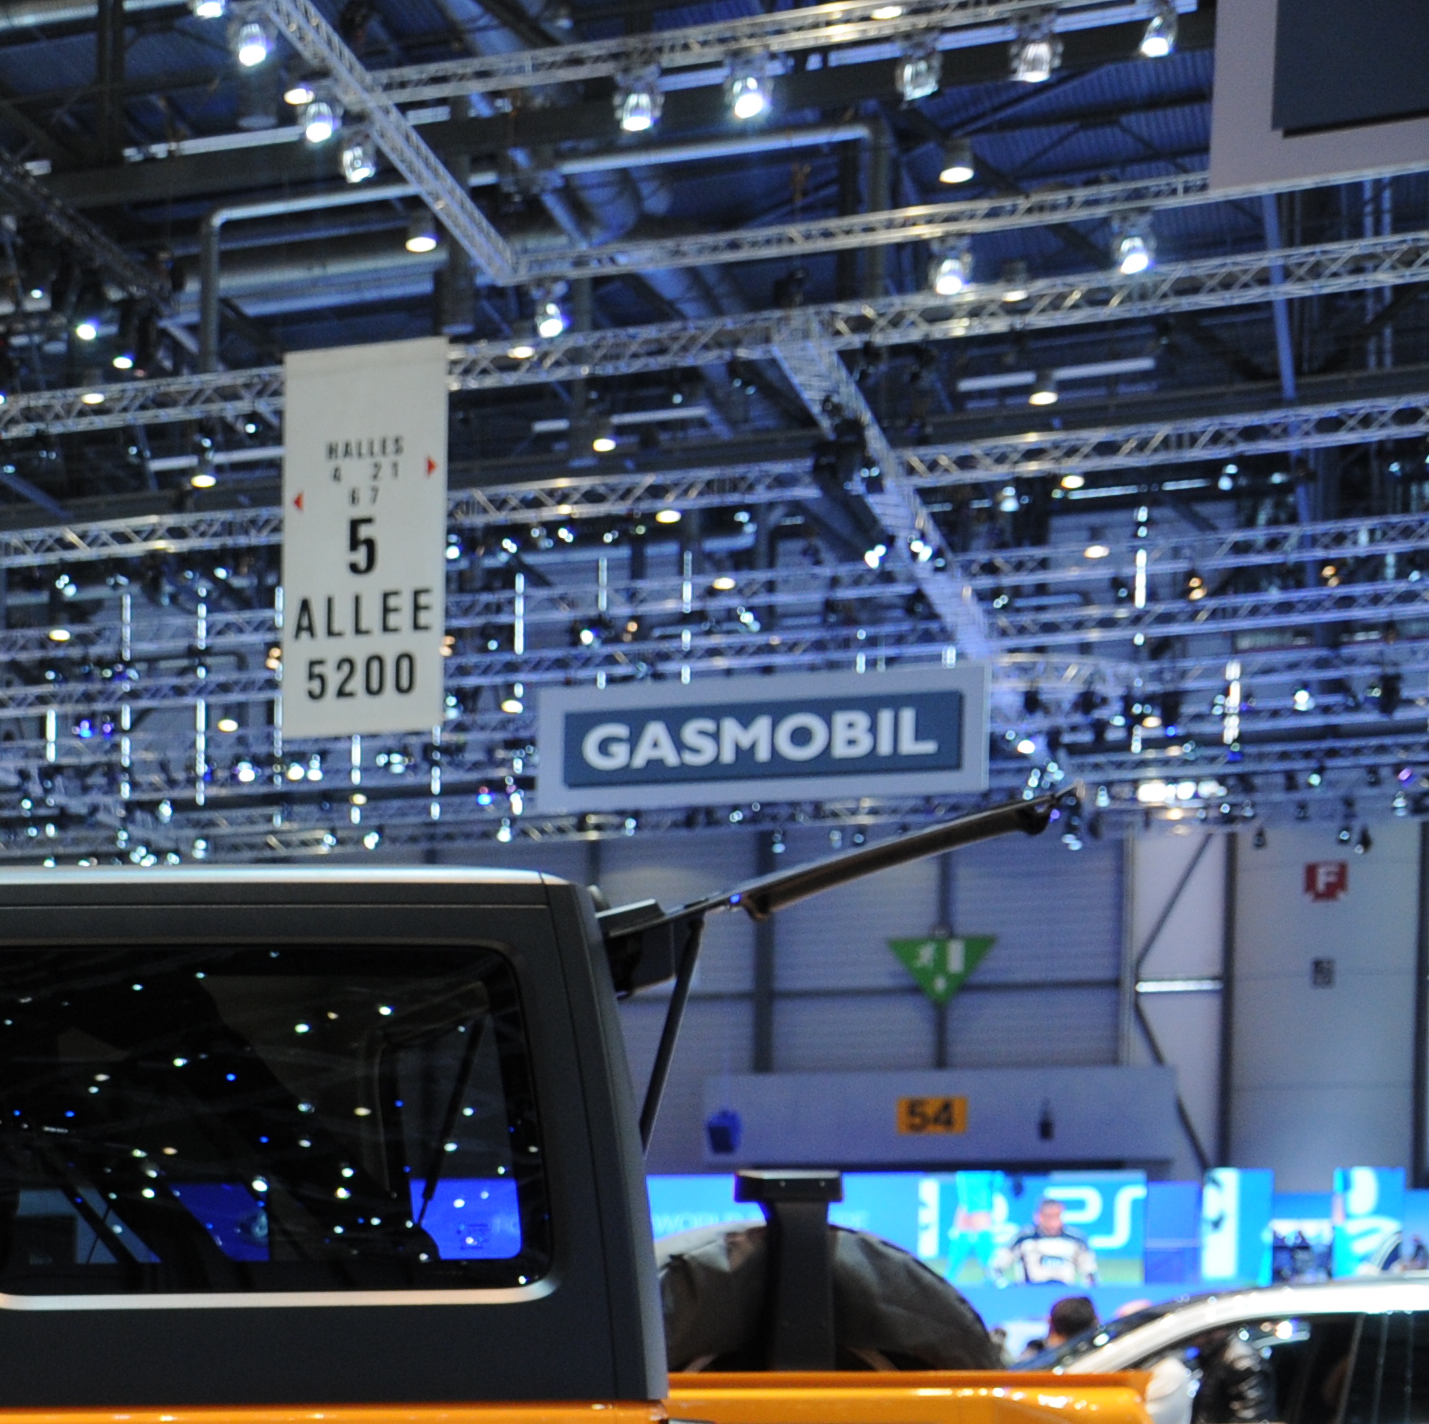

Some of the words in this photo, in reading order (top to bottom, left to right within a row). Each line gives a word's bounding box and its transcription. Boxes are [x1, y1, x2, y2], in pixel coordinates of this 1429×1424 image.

[325, 436, 404, 460] HALLES
[348, 516, 377, 575] 5
[294, 587, 433, 640] ALLEE
[307, 652, 416, 701] 5200
[581, 706, 939, 771] GASMOBIL
[908, 1099, 954, 1132] 54
